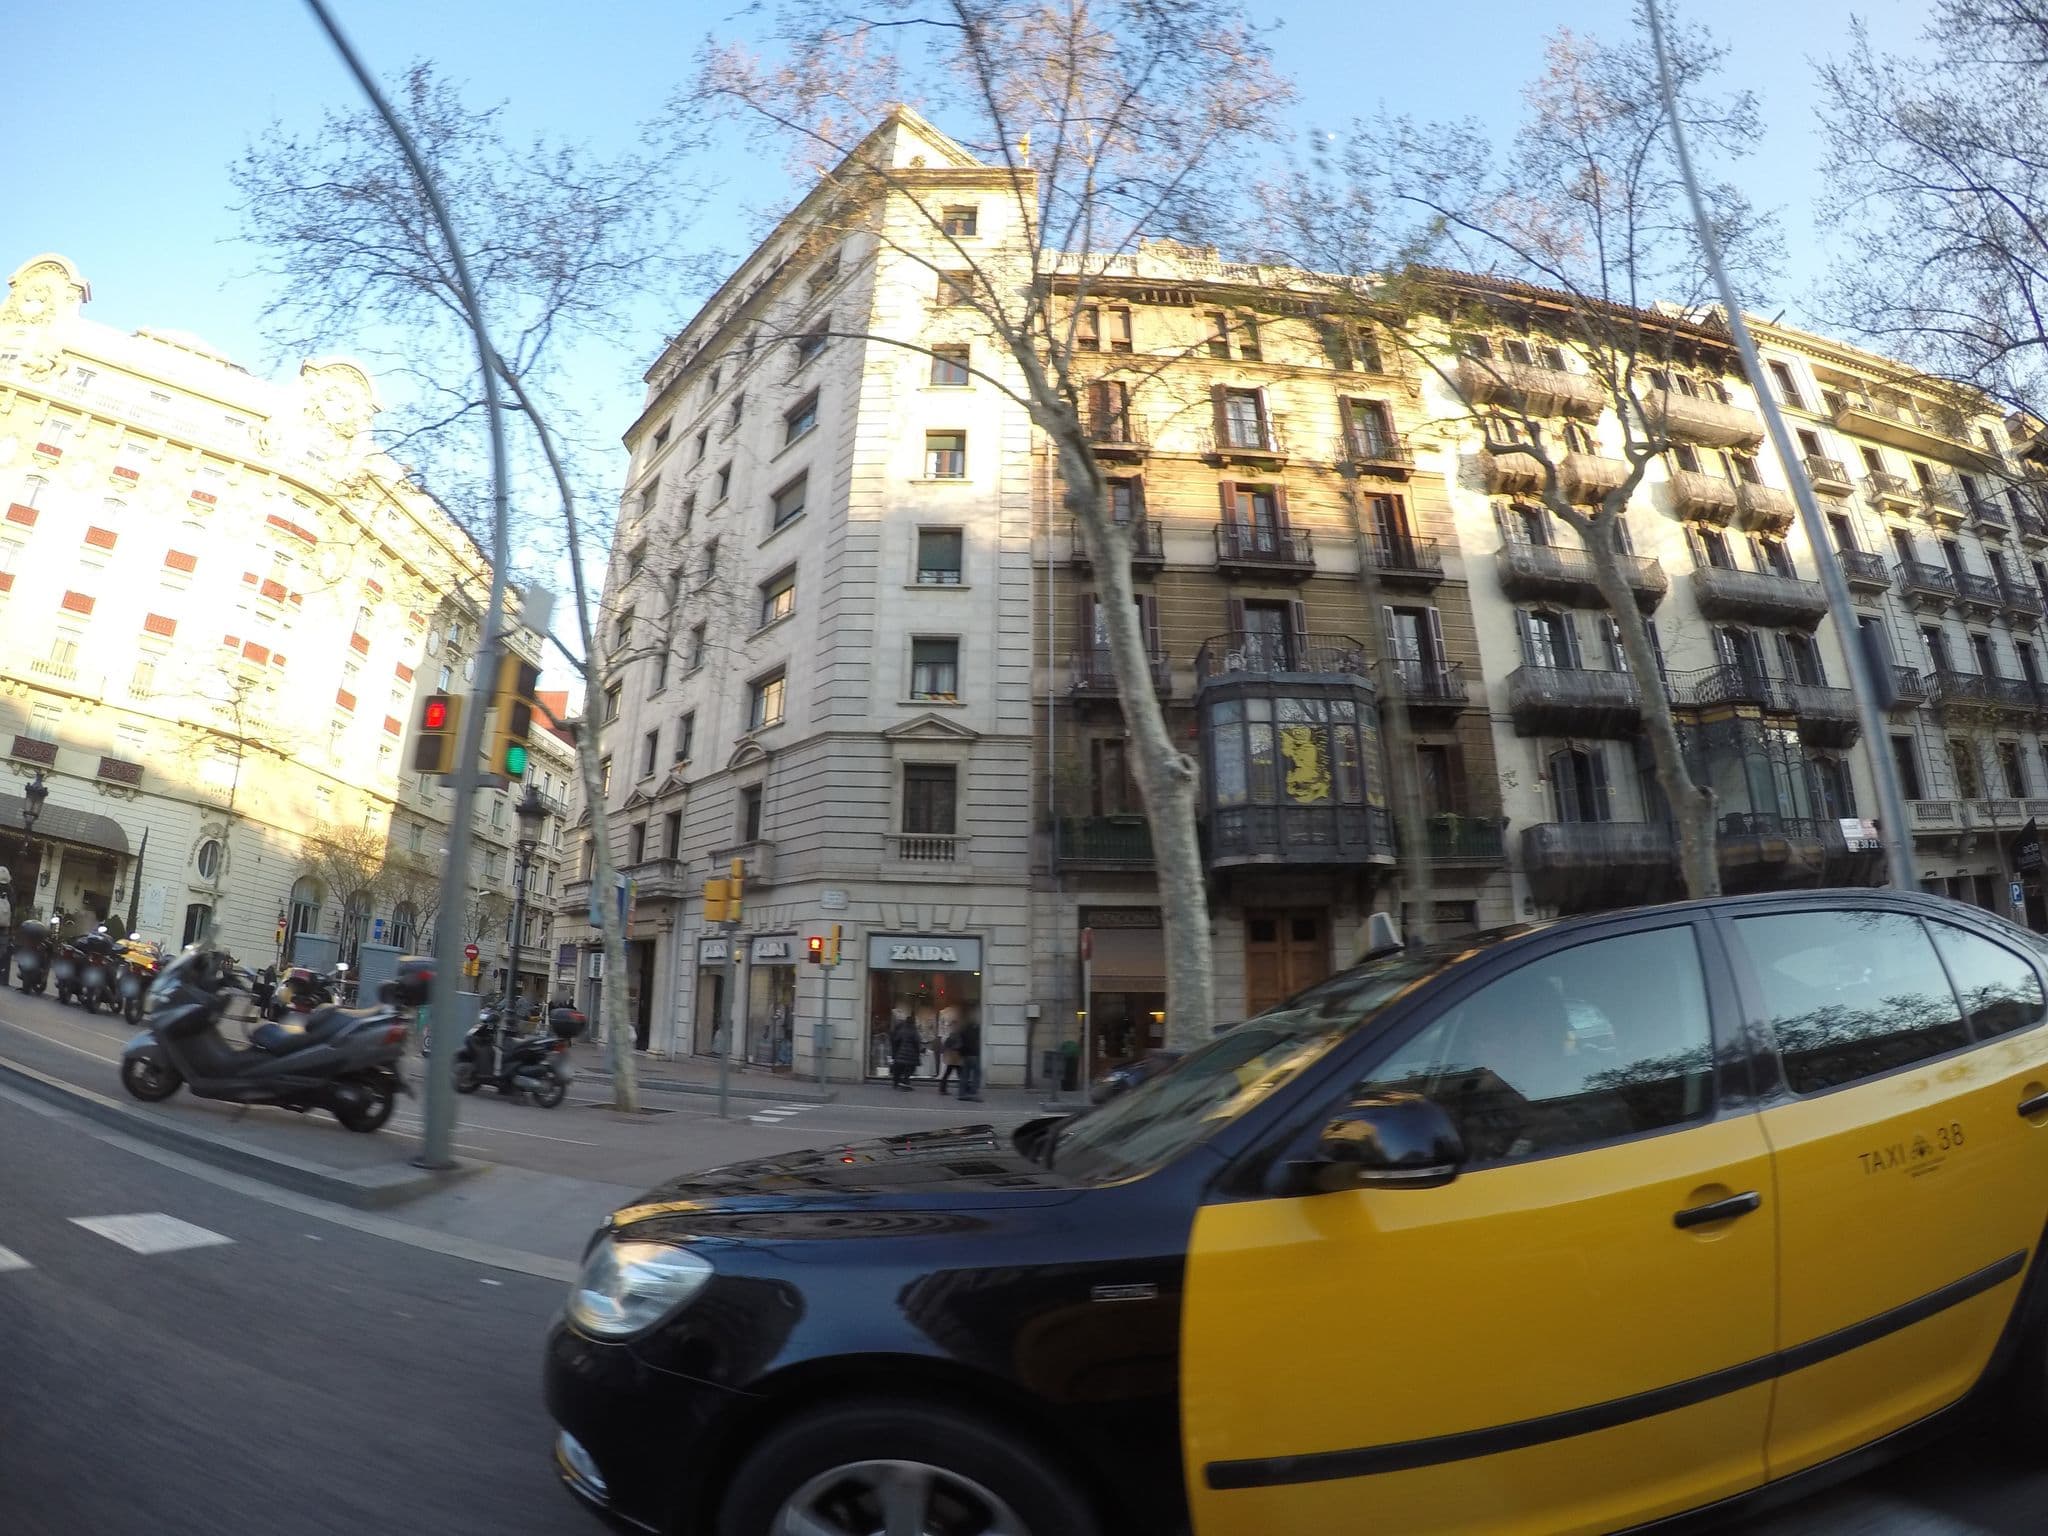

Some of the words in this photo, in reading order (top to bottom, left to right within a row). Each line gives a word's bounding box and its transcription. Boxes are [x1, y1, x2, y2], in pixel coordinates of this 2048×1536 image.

[2012, 884, 2020, 900] P
[1856, 1143, 1906, 1176] TAXI
[1937, 1120, 1966, 1151] 38
